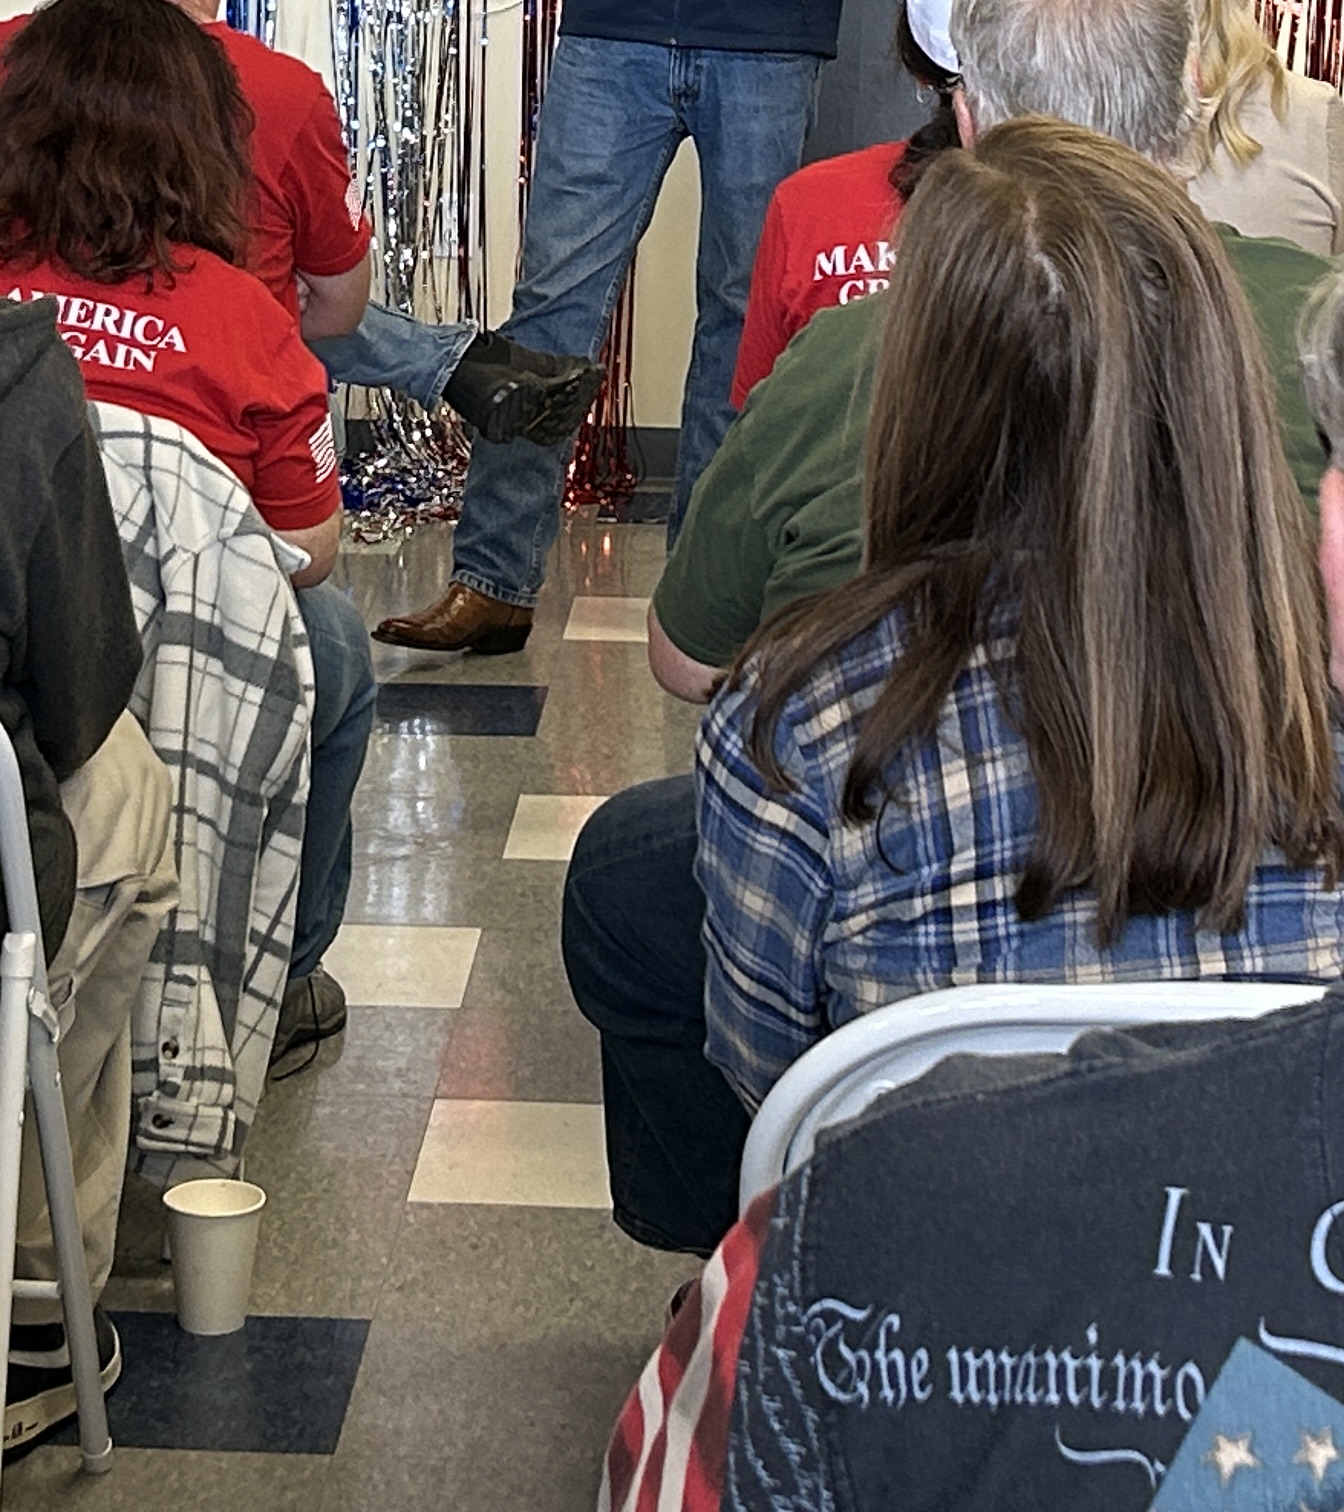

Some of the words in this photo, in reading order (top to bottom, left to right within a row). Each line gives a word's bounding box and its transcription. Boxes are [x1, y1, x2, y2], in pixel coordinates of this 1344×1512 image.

[812, 241, 898, 281] MAK
[60, 332, 157, 372] GAIN
[804, 1298, 933, 1412] The
[949, 1324, 1203, 1420] unanimo
